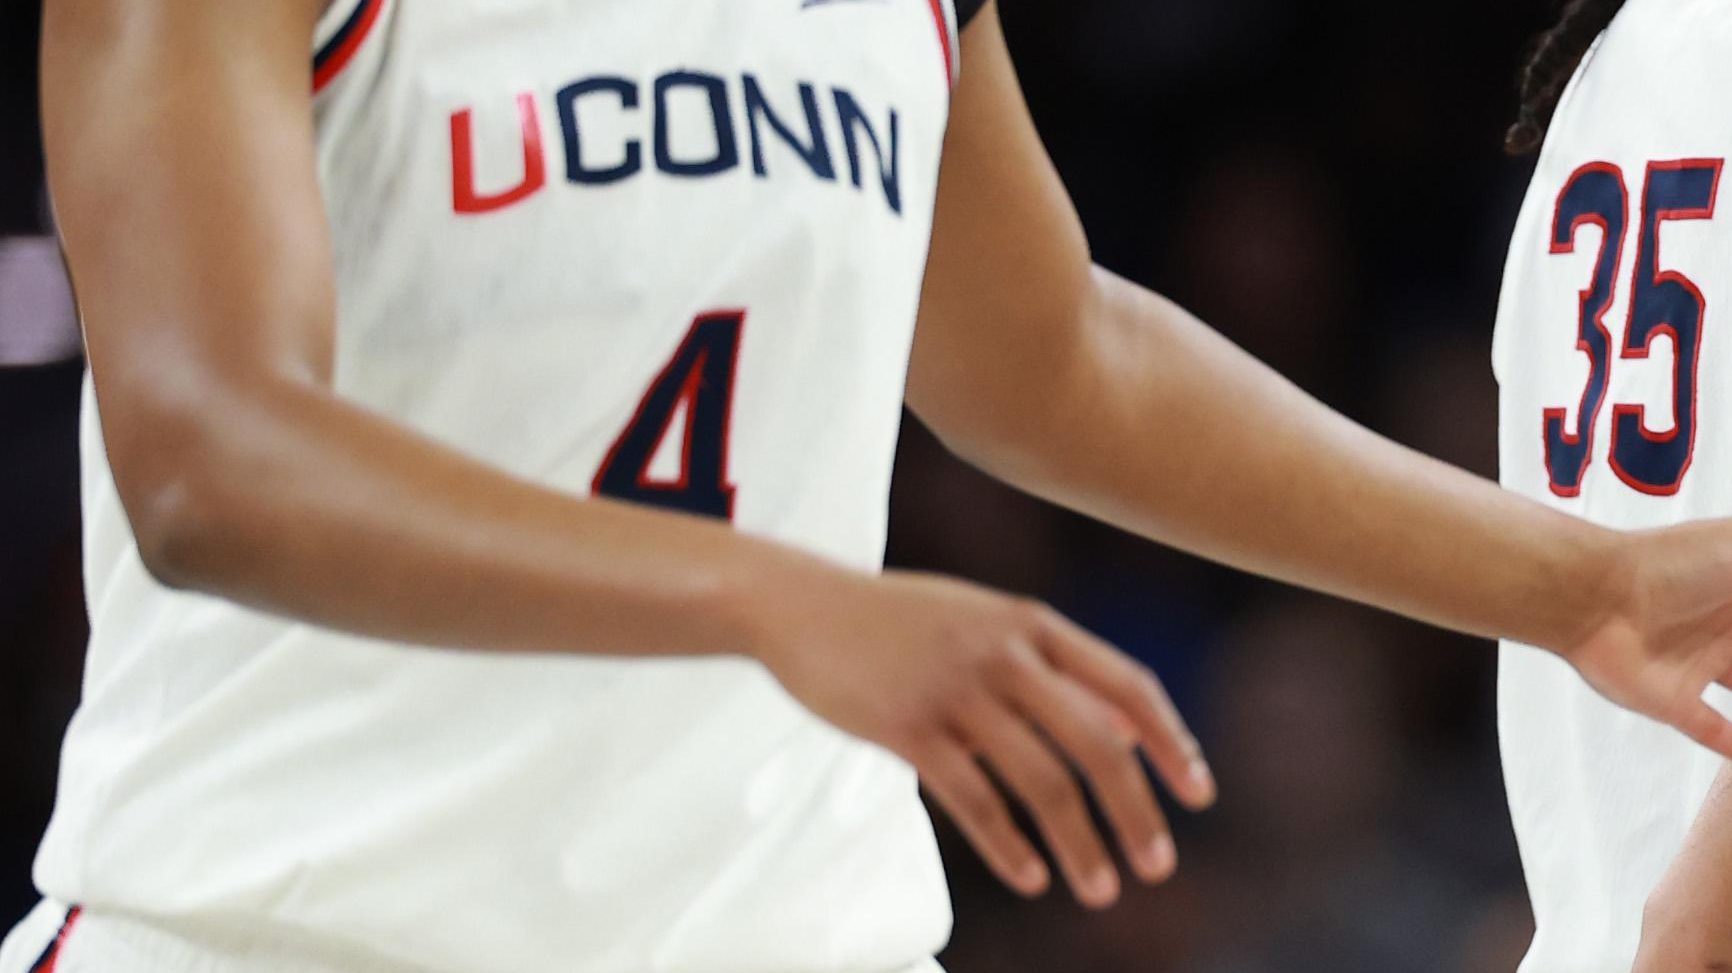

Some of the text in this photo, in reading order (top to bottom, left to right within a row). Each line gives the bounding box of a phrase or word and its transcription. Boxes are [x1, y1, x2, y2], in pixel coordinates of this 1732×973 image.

[450, 69, 903, 216] UCONN
[591, 307, 746, 523] 4
[1543, 158, 1725, 498] 35
